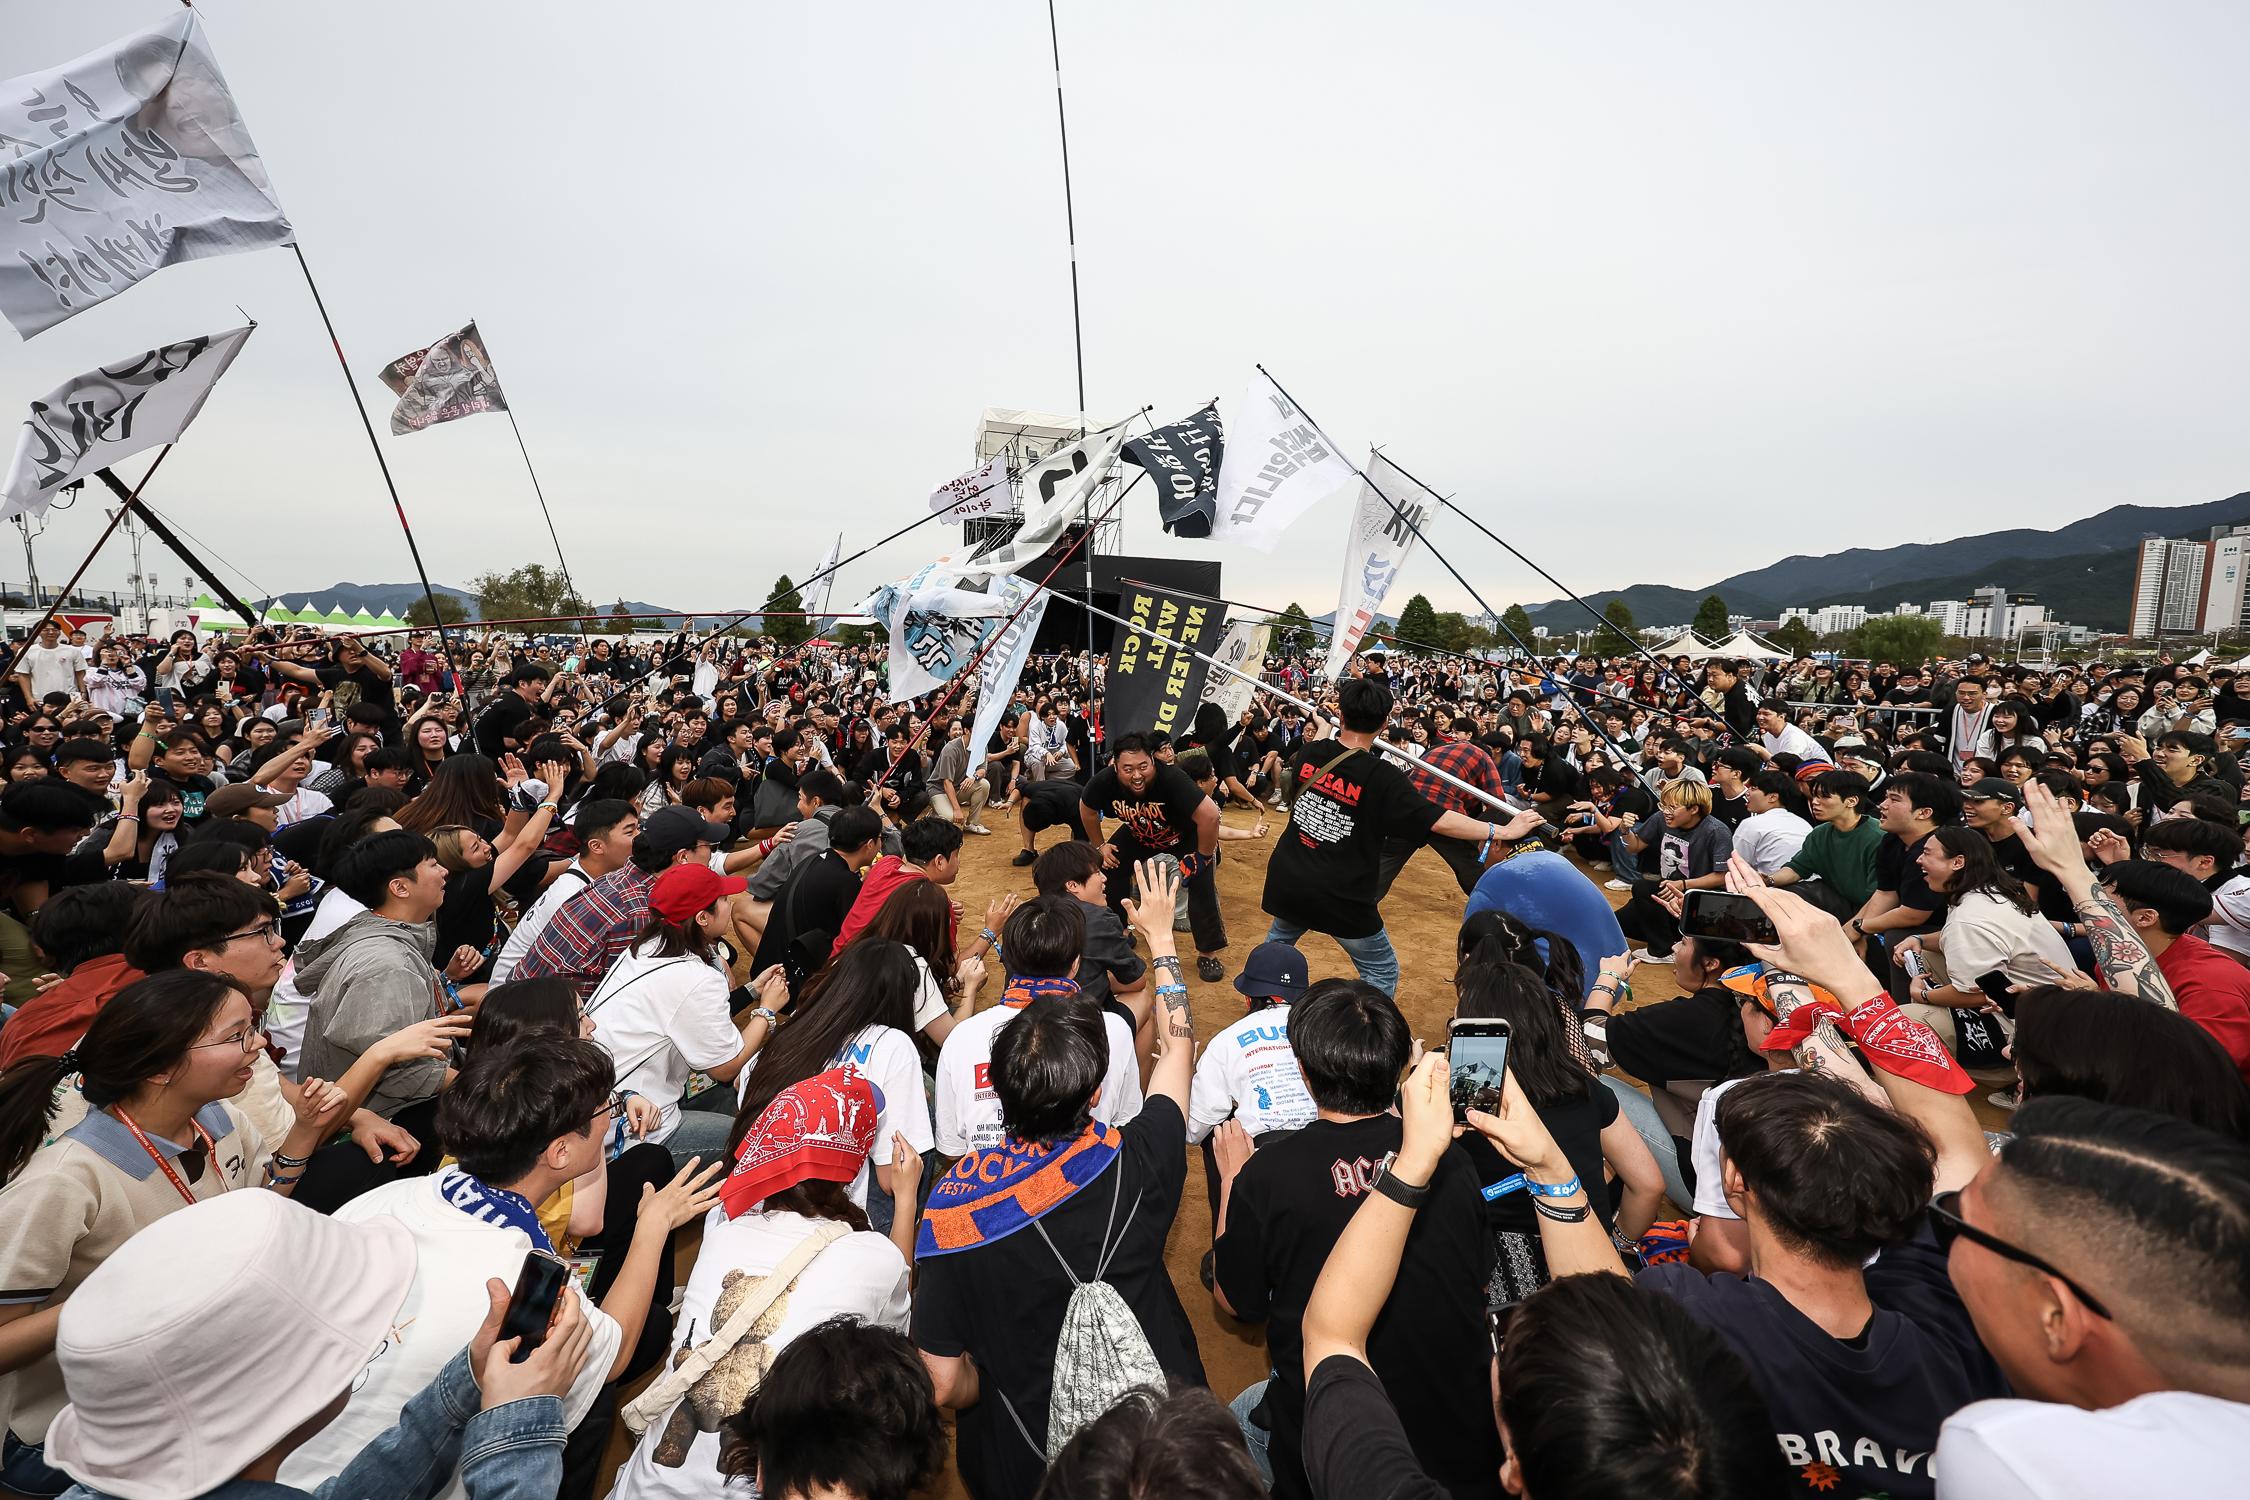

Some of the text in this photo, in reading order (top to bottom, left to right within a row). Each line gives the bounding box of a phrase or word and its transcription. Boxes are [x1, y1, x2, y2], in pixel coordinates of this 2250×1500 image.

[1299, 763, 1362, 801] BUSAN
[1866, 1021, 1888, 1044] OCTOBER
[1553, 1179, 1579, 1195] 2 DAY
[1776, 1428, 1938, 1480] BRAV
